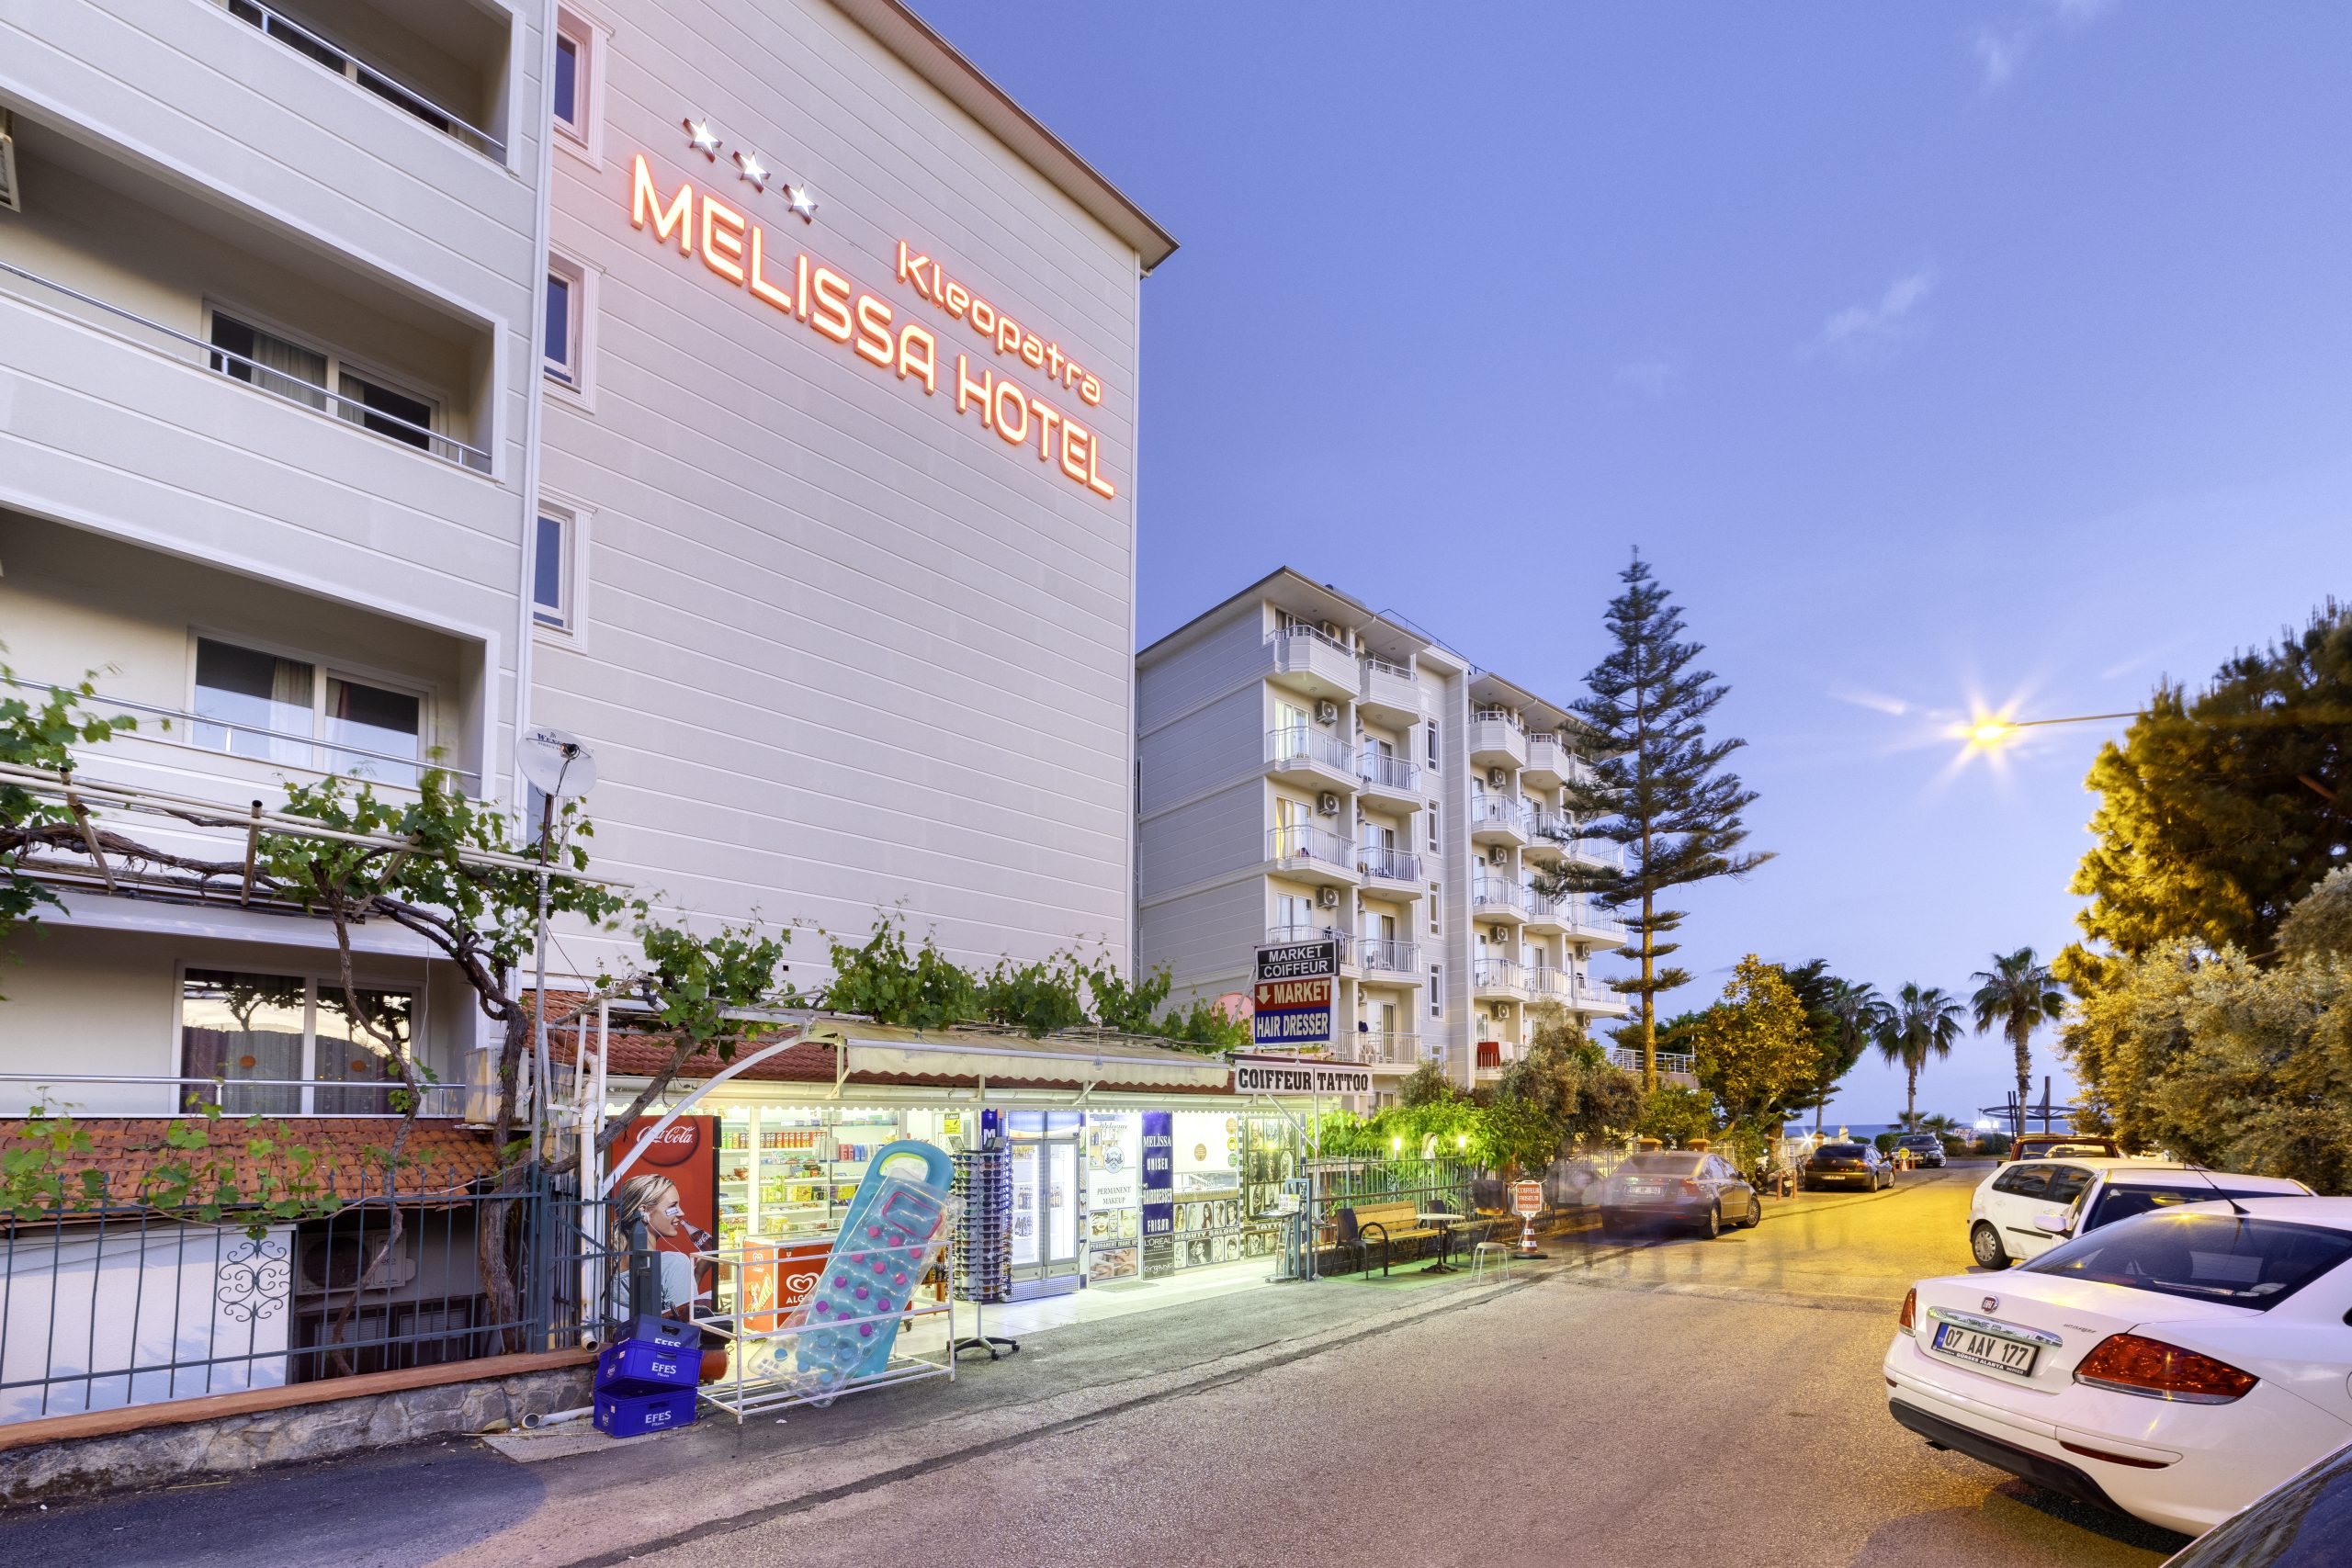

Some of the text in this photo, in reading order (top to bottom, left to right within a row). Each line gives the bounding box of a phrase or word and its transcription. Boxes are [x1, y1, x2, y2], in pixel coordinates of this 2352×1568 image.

[631, 154, 1114, 499] MELISSA HOTEL
[897, 240, 1102, 408] Kleopatra
[1269, 945, 1323, 963] MARKET
[1264, 960, 1329, 978] COIFFEUR
[1273, 980, 1330, 1004] MARKET
[1257, 1013, 1329, 1037] HAIR DRESSER
[1238, 1068, 1369, 1091] COIFFEUR TATTOO
[1147, 1157, 1169, 1171] UNISEX
[1097, 1186, 1131, 1195] PERMANENT
[1102, 1197, 1126, 1205] MAKEUP
[1174, 1227, 1239, 1240] BEAUTY SALOON
[1945, 1329, 2030, 1367] 07 AAV 177
[651, 1361, 677, 1374] EFES
[1980, 1359, 2004, 1371] ALANYA
[645, 1410, 672, 1424] EFES
